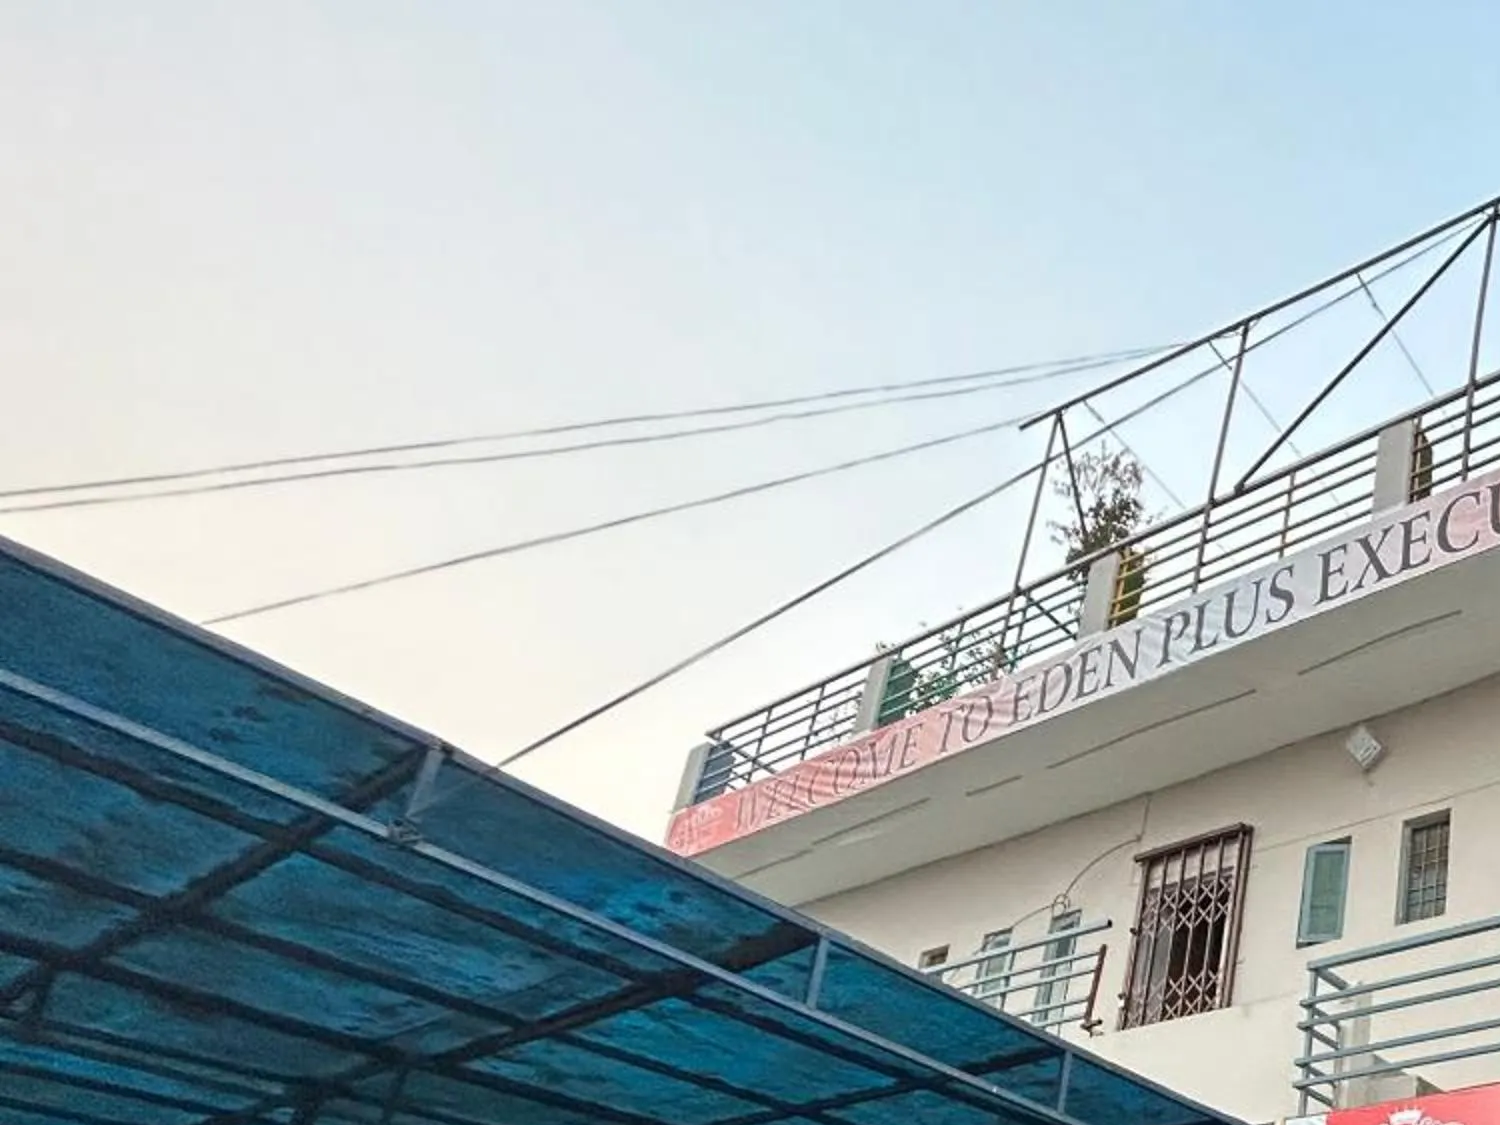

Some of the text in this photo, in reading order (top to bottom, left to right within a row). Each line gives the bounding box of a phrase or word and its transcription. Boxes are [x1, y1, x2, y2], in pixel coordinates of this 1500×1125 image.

[940, 695, 992, 755] TO
[1009, 641, 1142, 723] EDEN
[1157, 565, 1298, 667] PLUS
